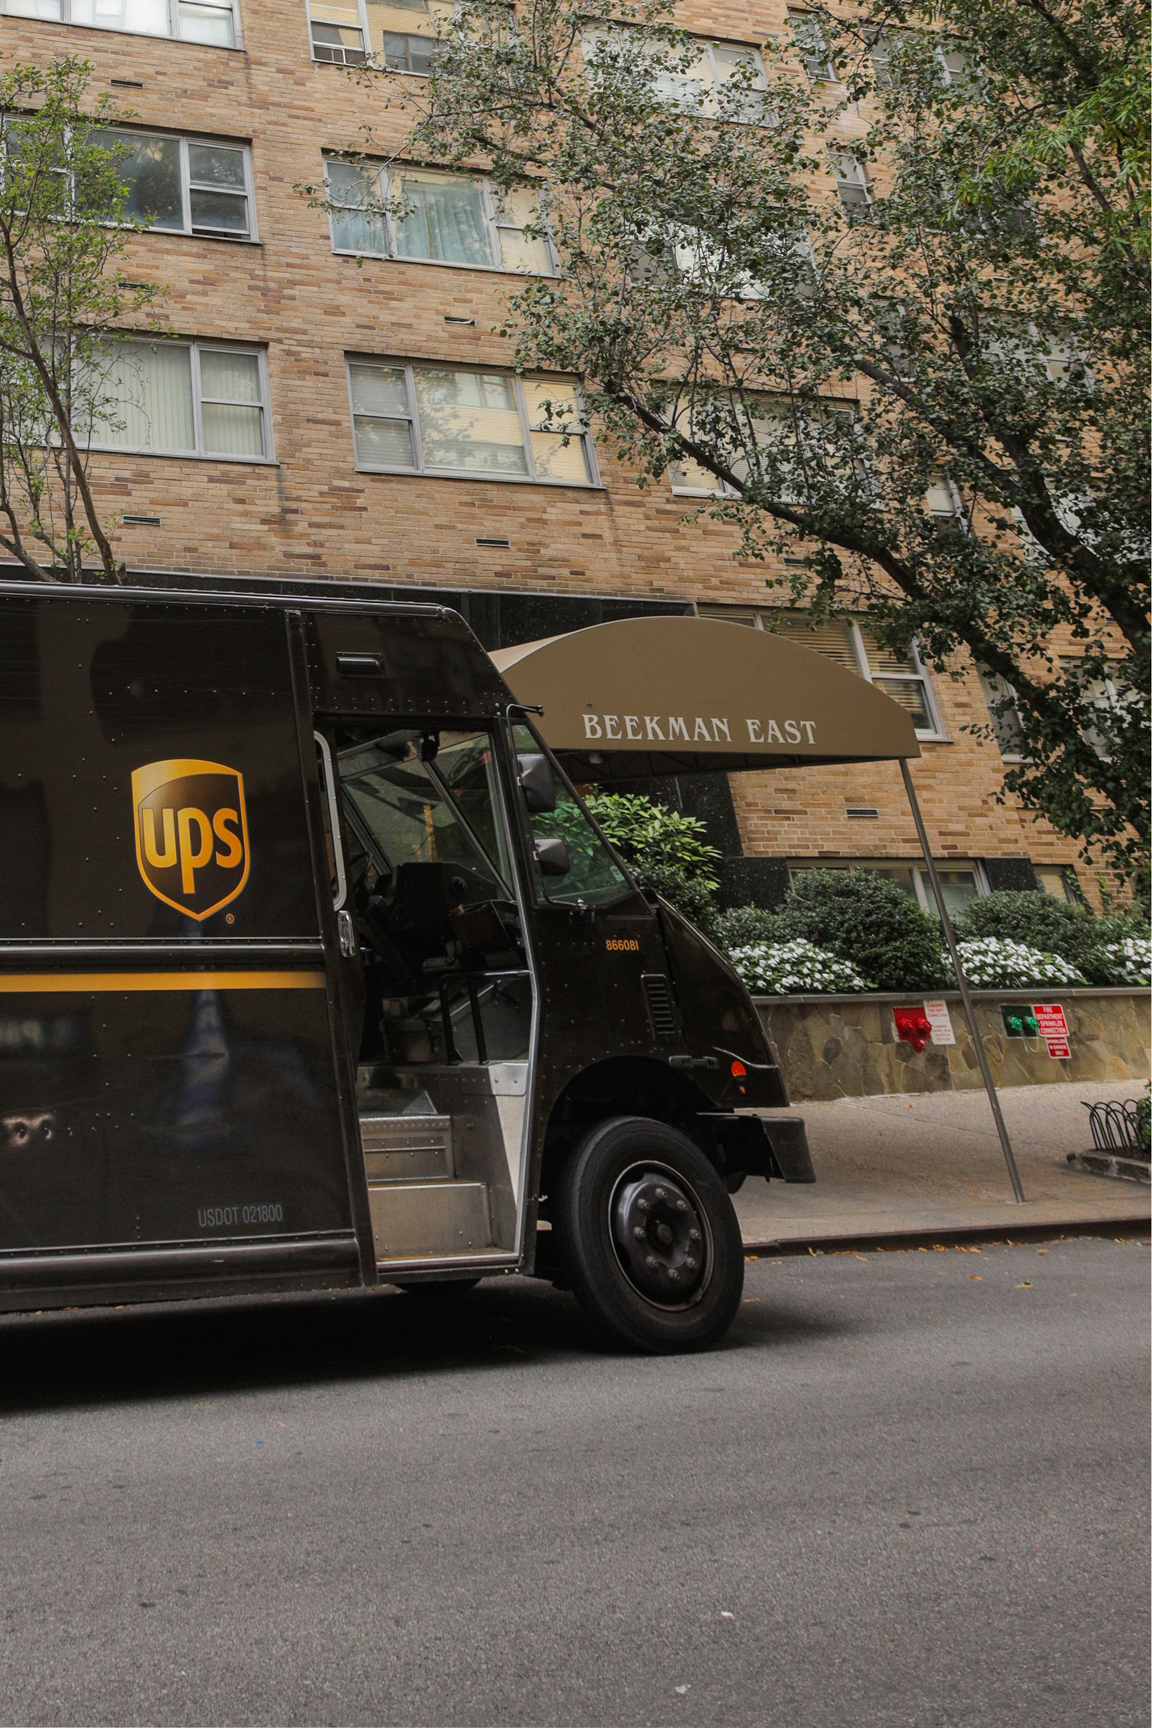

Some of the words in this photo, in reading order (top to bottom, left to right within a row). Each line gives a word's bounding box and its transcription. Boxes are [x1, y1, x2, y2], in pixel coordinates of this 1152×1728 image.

[582, 714, 733, 742] BEEKMAN
[745, 718, 817, 745] EAST
[142, 807, 243, 894] ups
[605, 939, 640, 951] 866081
[1035, 1013, 1063, 1021] DEPARTMENT
[198, 1206, 239, 1227] USDOT
[242, 1204, 283, 1224] 021800
